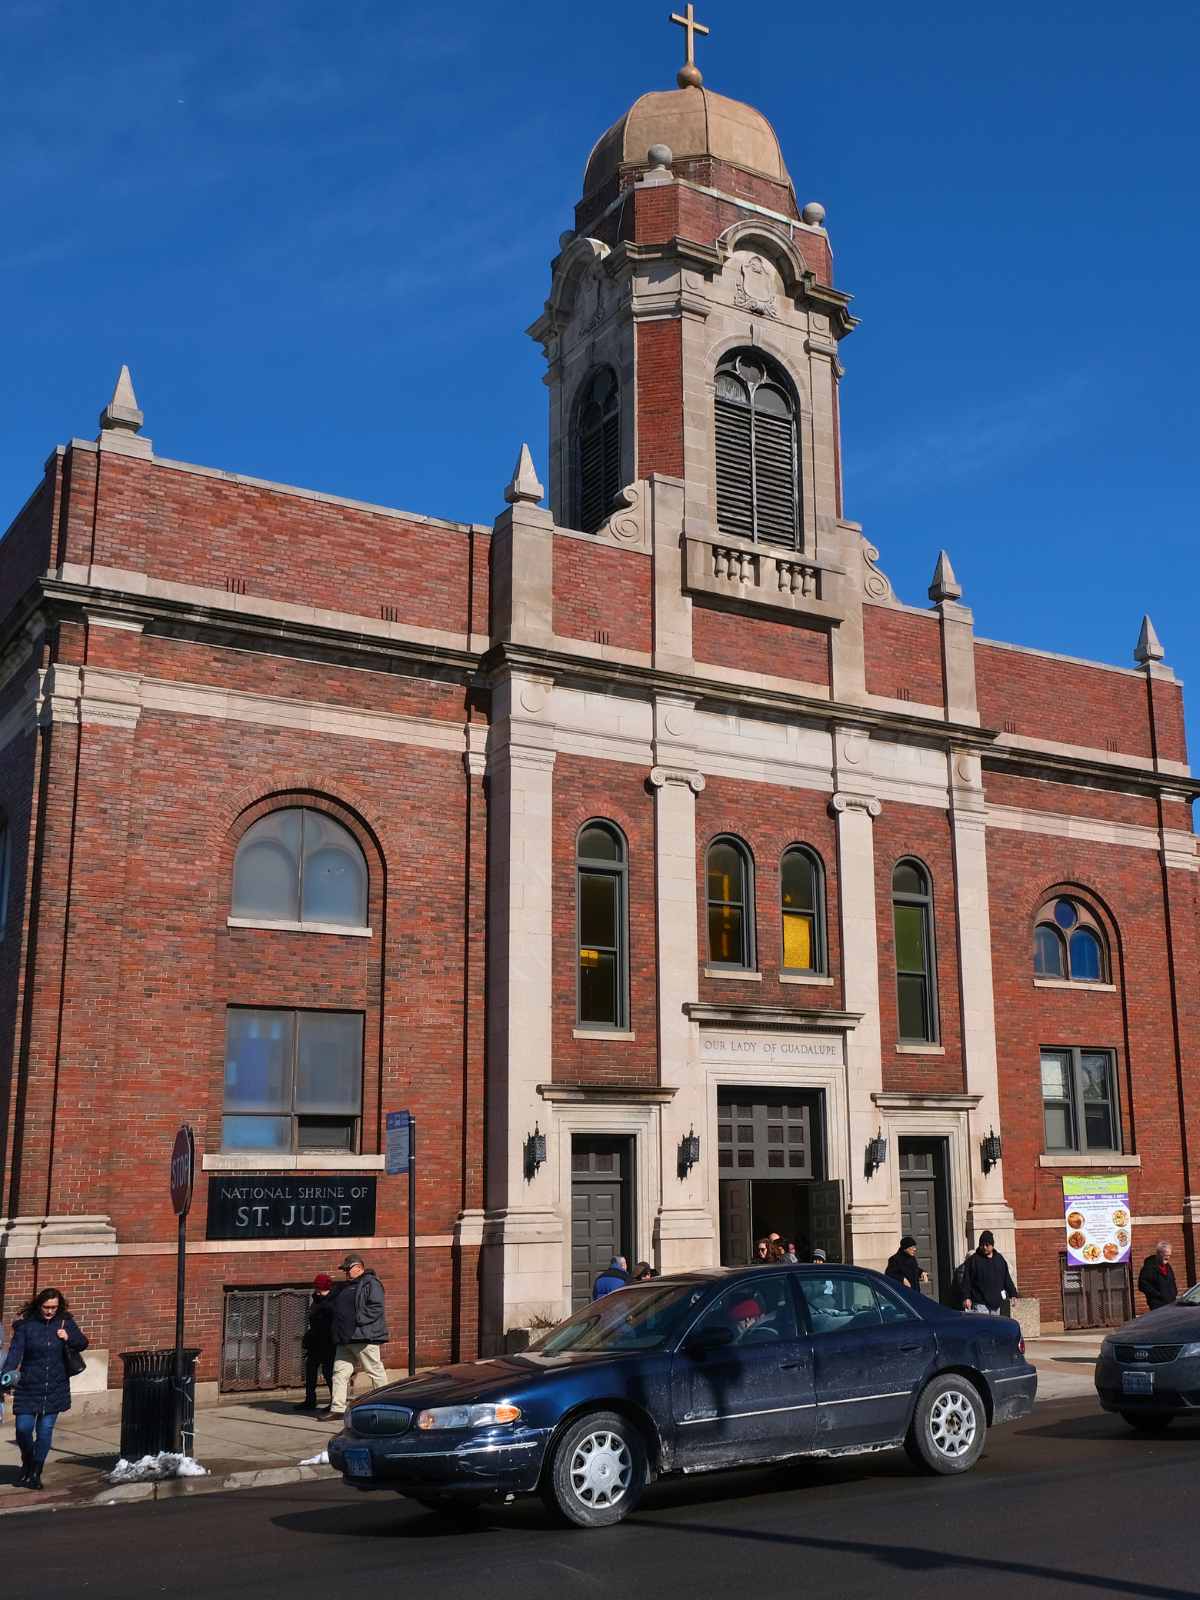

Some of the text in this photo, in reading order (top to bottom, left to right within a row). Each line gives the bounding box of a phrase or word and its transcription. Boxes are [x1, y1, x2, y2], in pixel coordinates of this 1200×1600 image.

[704, 1040, 837, 1056] OUR LADY OF GUADALUPE
[172, 1153, 189, 1190] STOP
[220, 1186, 369, 1200] NATIONAL SHRINE OF
[235, 1205, 352, 1227] ST. JUDE
